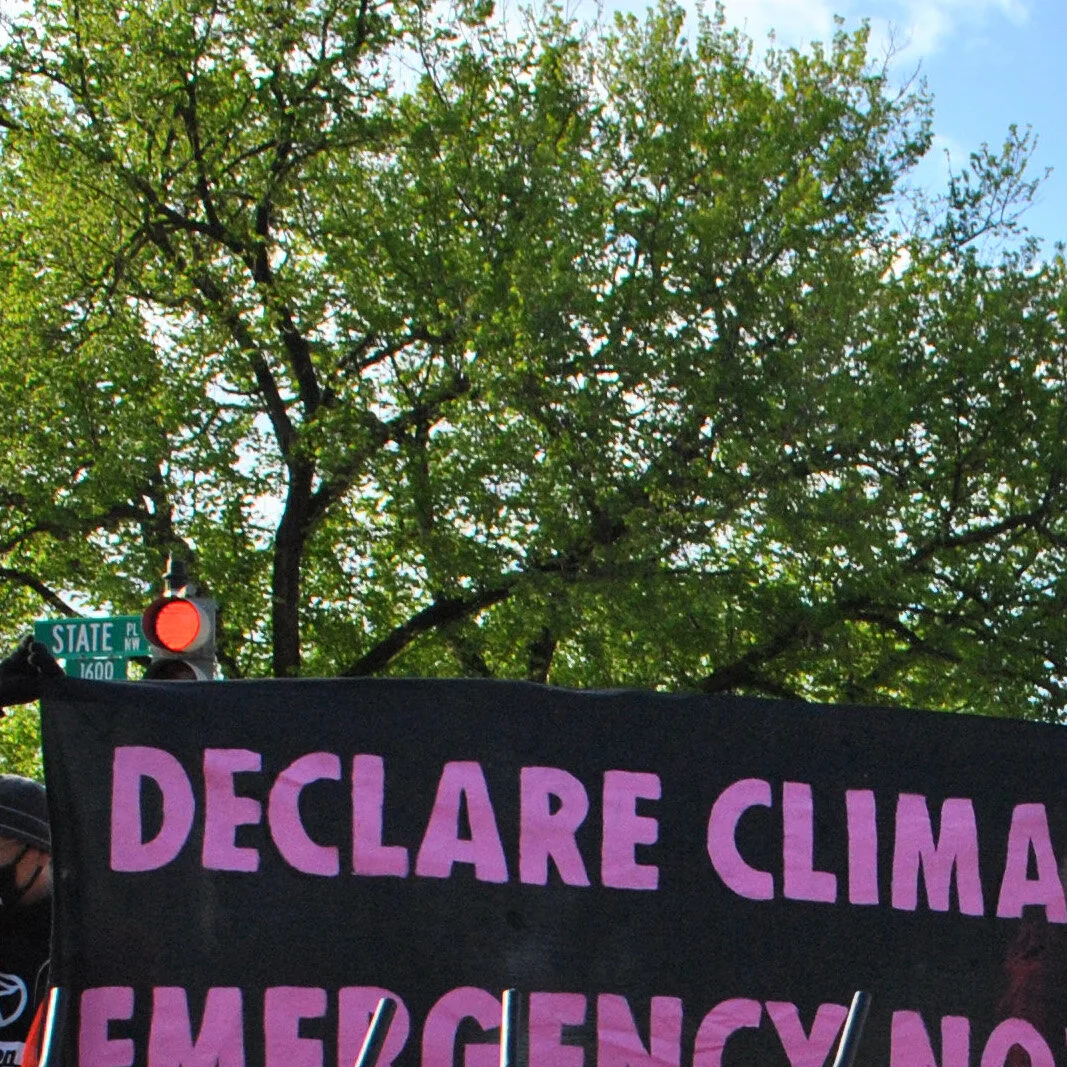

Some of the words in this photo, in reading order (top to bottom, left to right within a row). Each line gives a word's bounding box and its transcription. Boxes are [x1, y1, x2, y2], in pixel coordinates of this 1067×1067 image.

[52, 622, 114, 653] STATE
[126, 622, 138, 636] PL
[124, 638, 140, 652] NW
[80, 661, 114, 679] 1600
[110, 746, 662, 890] DECLARE
